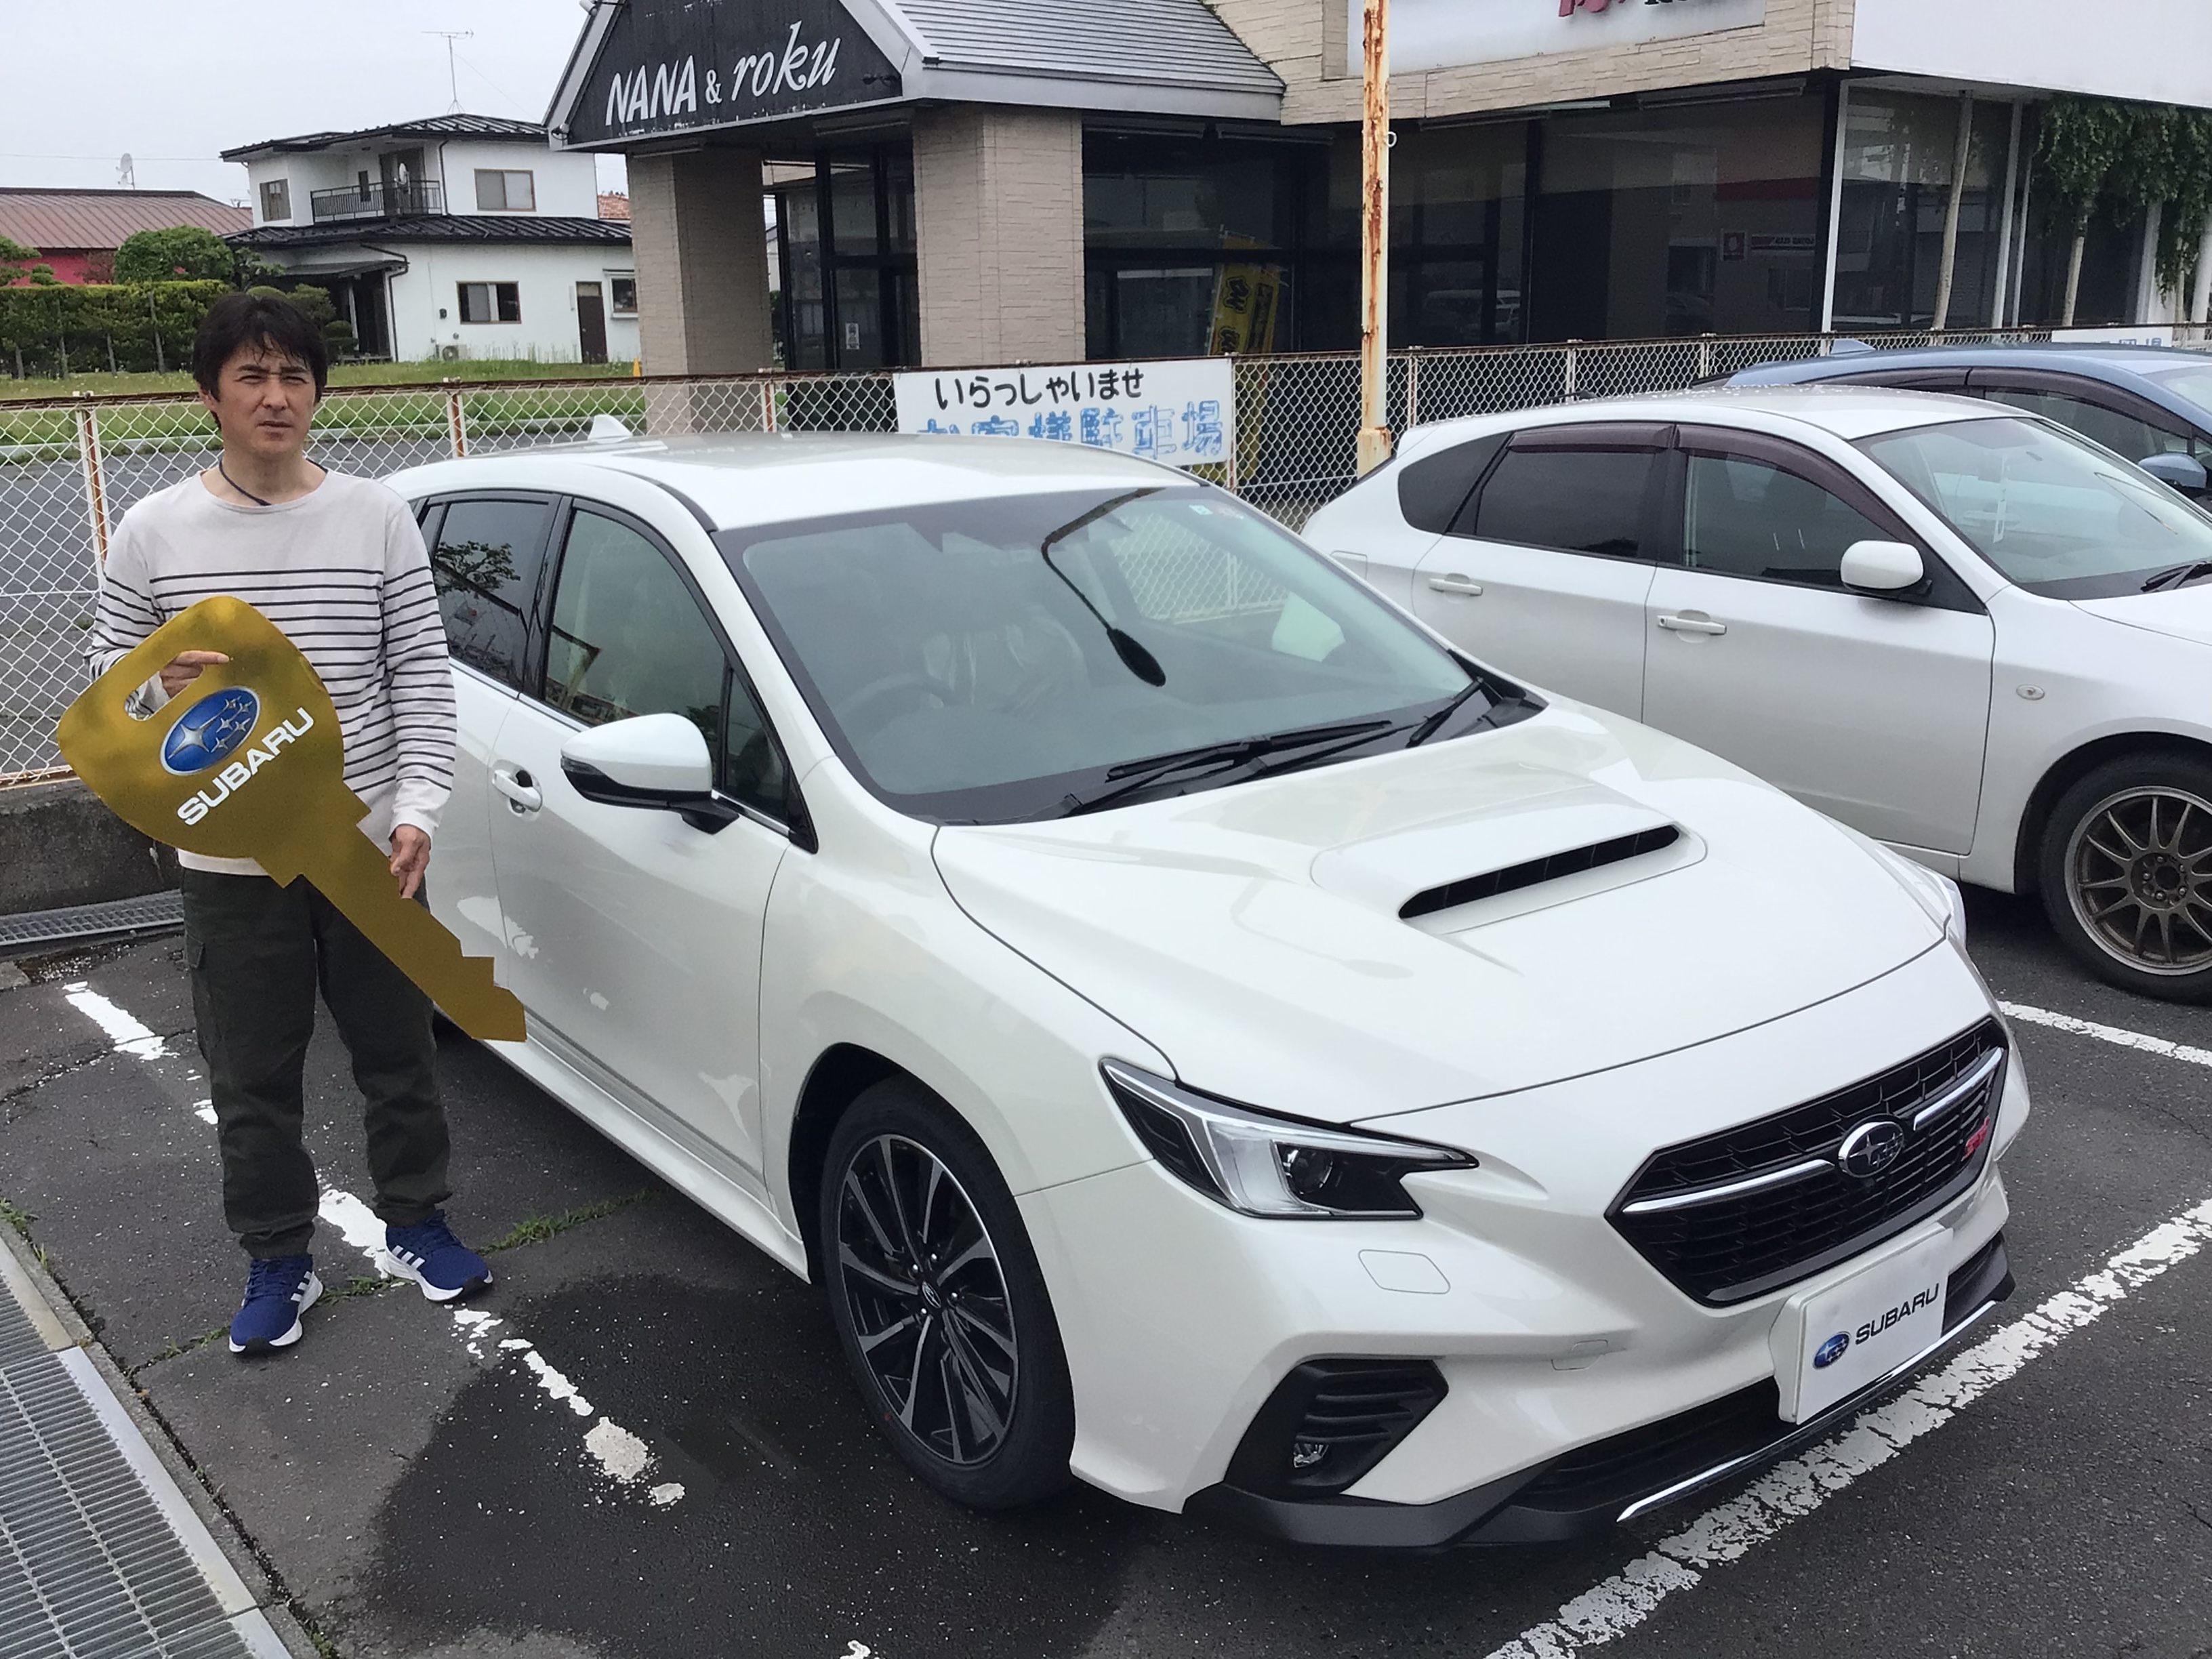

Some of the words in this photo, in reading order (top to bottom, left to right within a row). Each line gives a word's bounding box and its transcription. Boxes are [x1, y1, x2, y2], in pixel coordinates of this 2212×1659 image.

[605, 54, 697, 126] NANA
[705, 68, 722, 104] &
[731, 20, 842, 101] roku
[935, 367, 1144, 411] いらっしゃいませ
[917, 399, 1223, 459] 様駐車場
[176, 706, 314, 826] SUBARU
[1855, 1282, 1940, 1345] SUBARU
